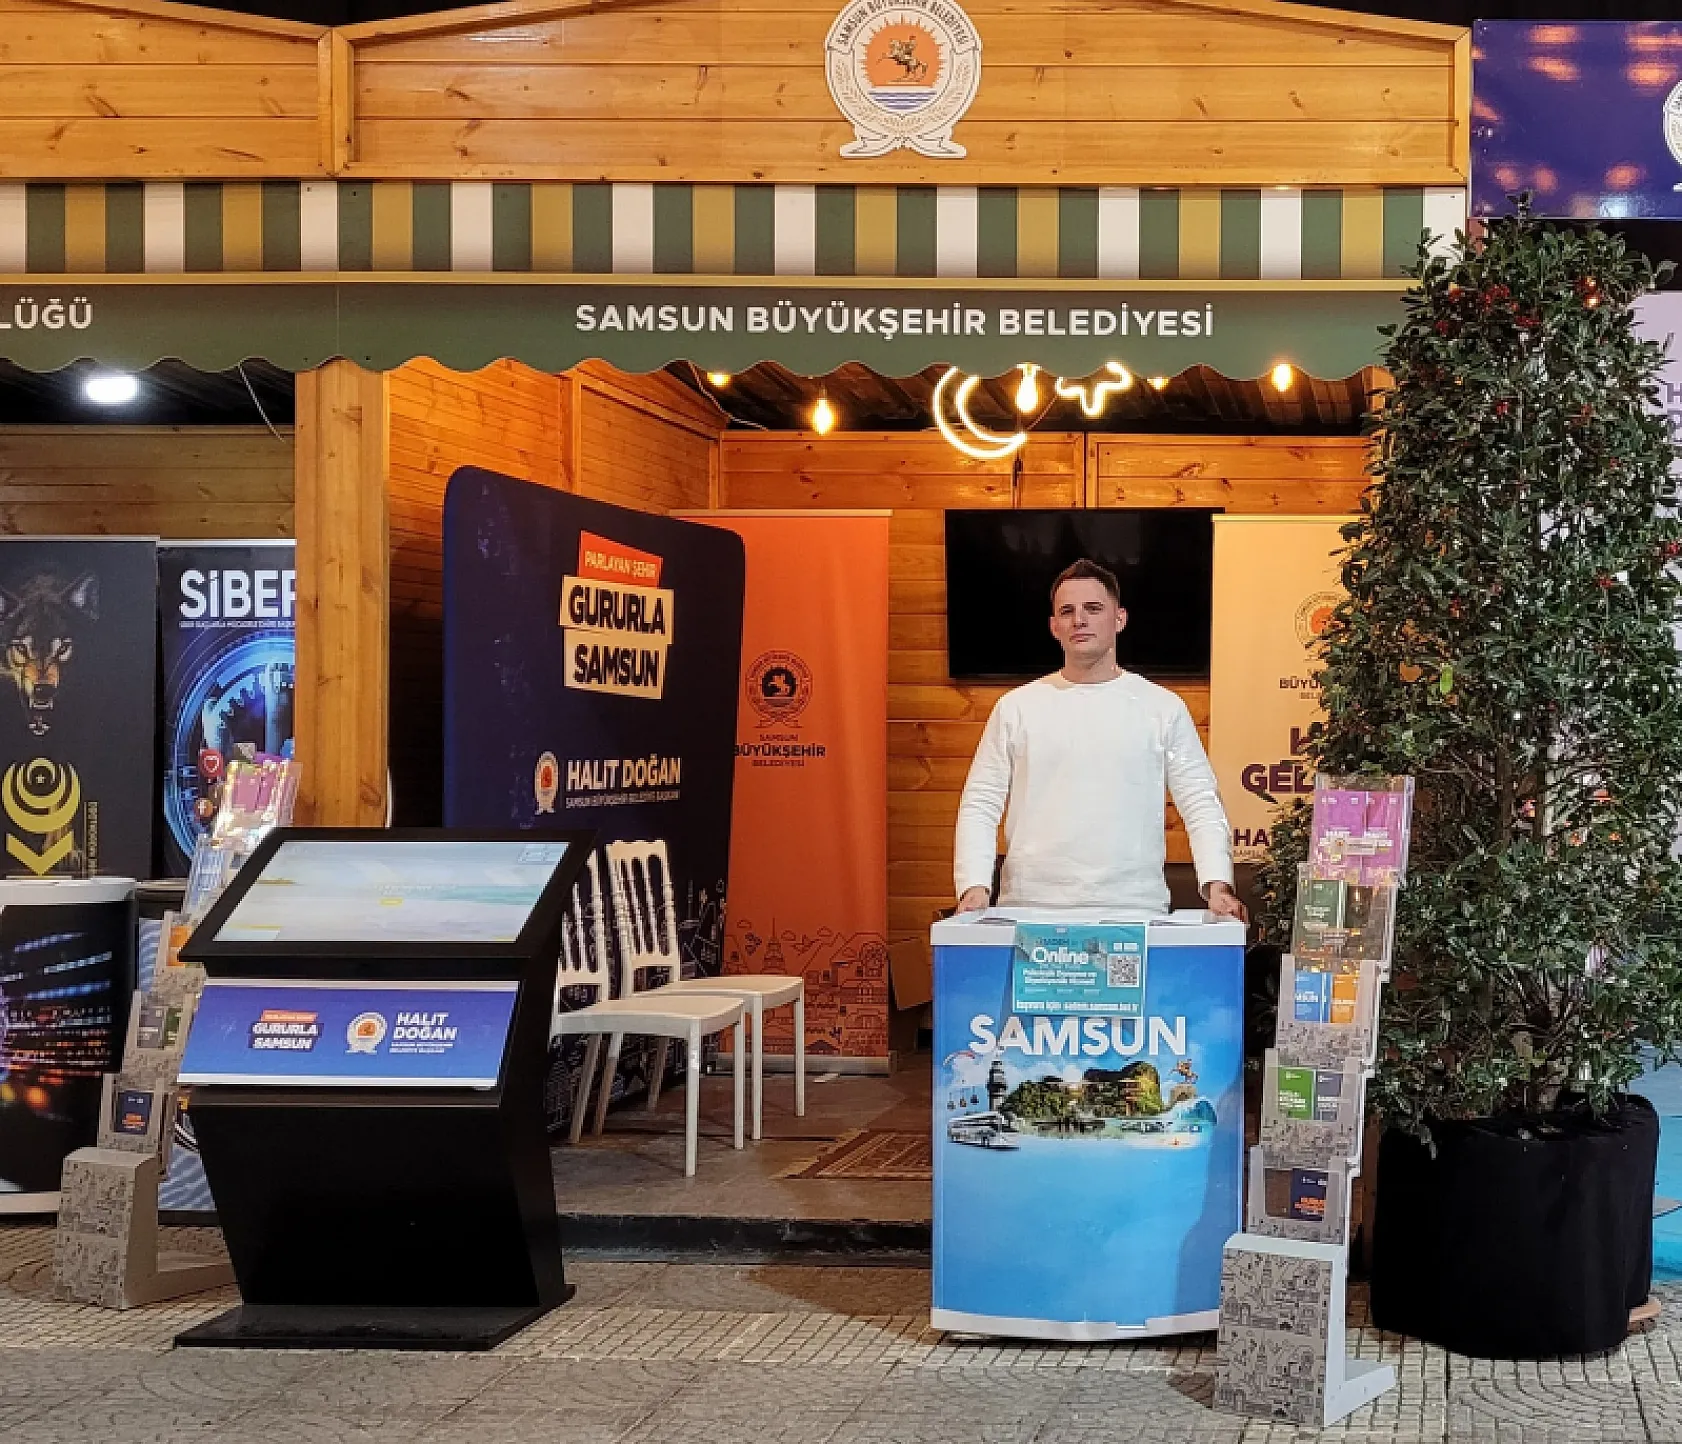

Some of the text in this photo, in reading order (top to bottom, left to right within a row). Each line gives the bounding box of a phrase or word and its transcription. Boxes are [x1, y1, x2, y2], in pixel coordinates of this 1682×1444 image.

[575, 300, 1213, 341] SAMSUN BÜYÜKŞEHİR BELEDİYESİ
[584, 551, 631, 574] PARLAYAN
[568, 585, 665, 636] GURURLA
[573, 643, 658, 687] SAMSUN
[1279, 675, 1322, 689] BÜYÜ
[733, 743, 826, 758] BÜYÜKŞEHİR
[622, 753, 681, 788] DOĞAN
[1241, 763, 1314, 794] GEL
[1233, 828, 1270, 847] HA
[1032, 946, 1089, 965] Online
[968, 1014, 1186, 1056] SAMSUN
